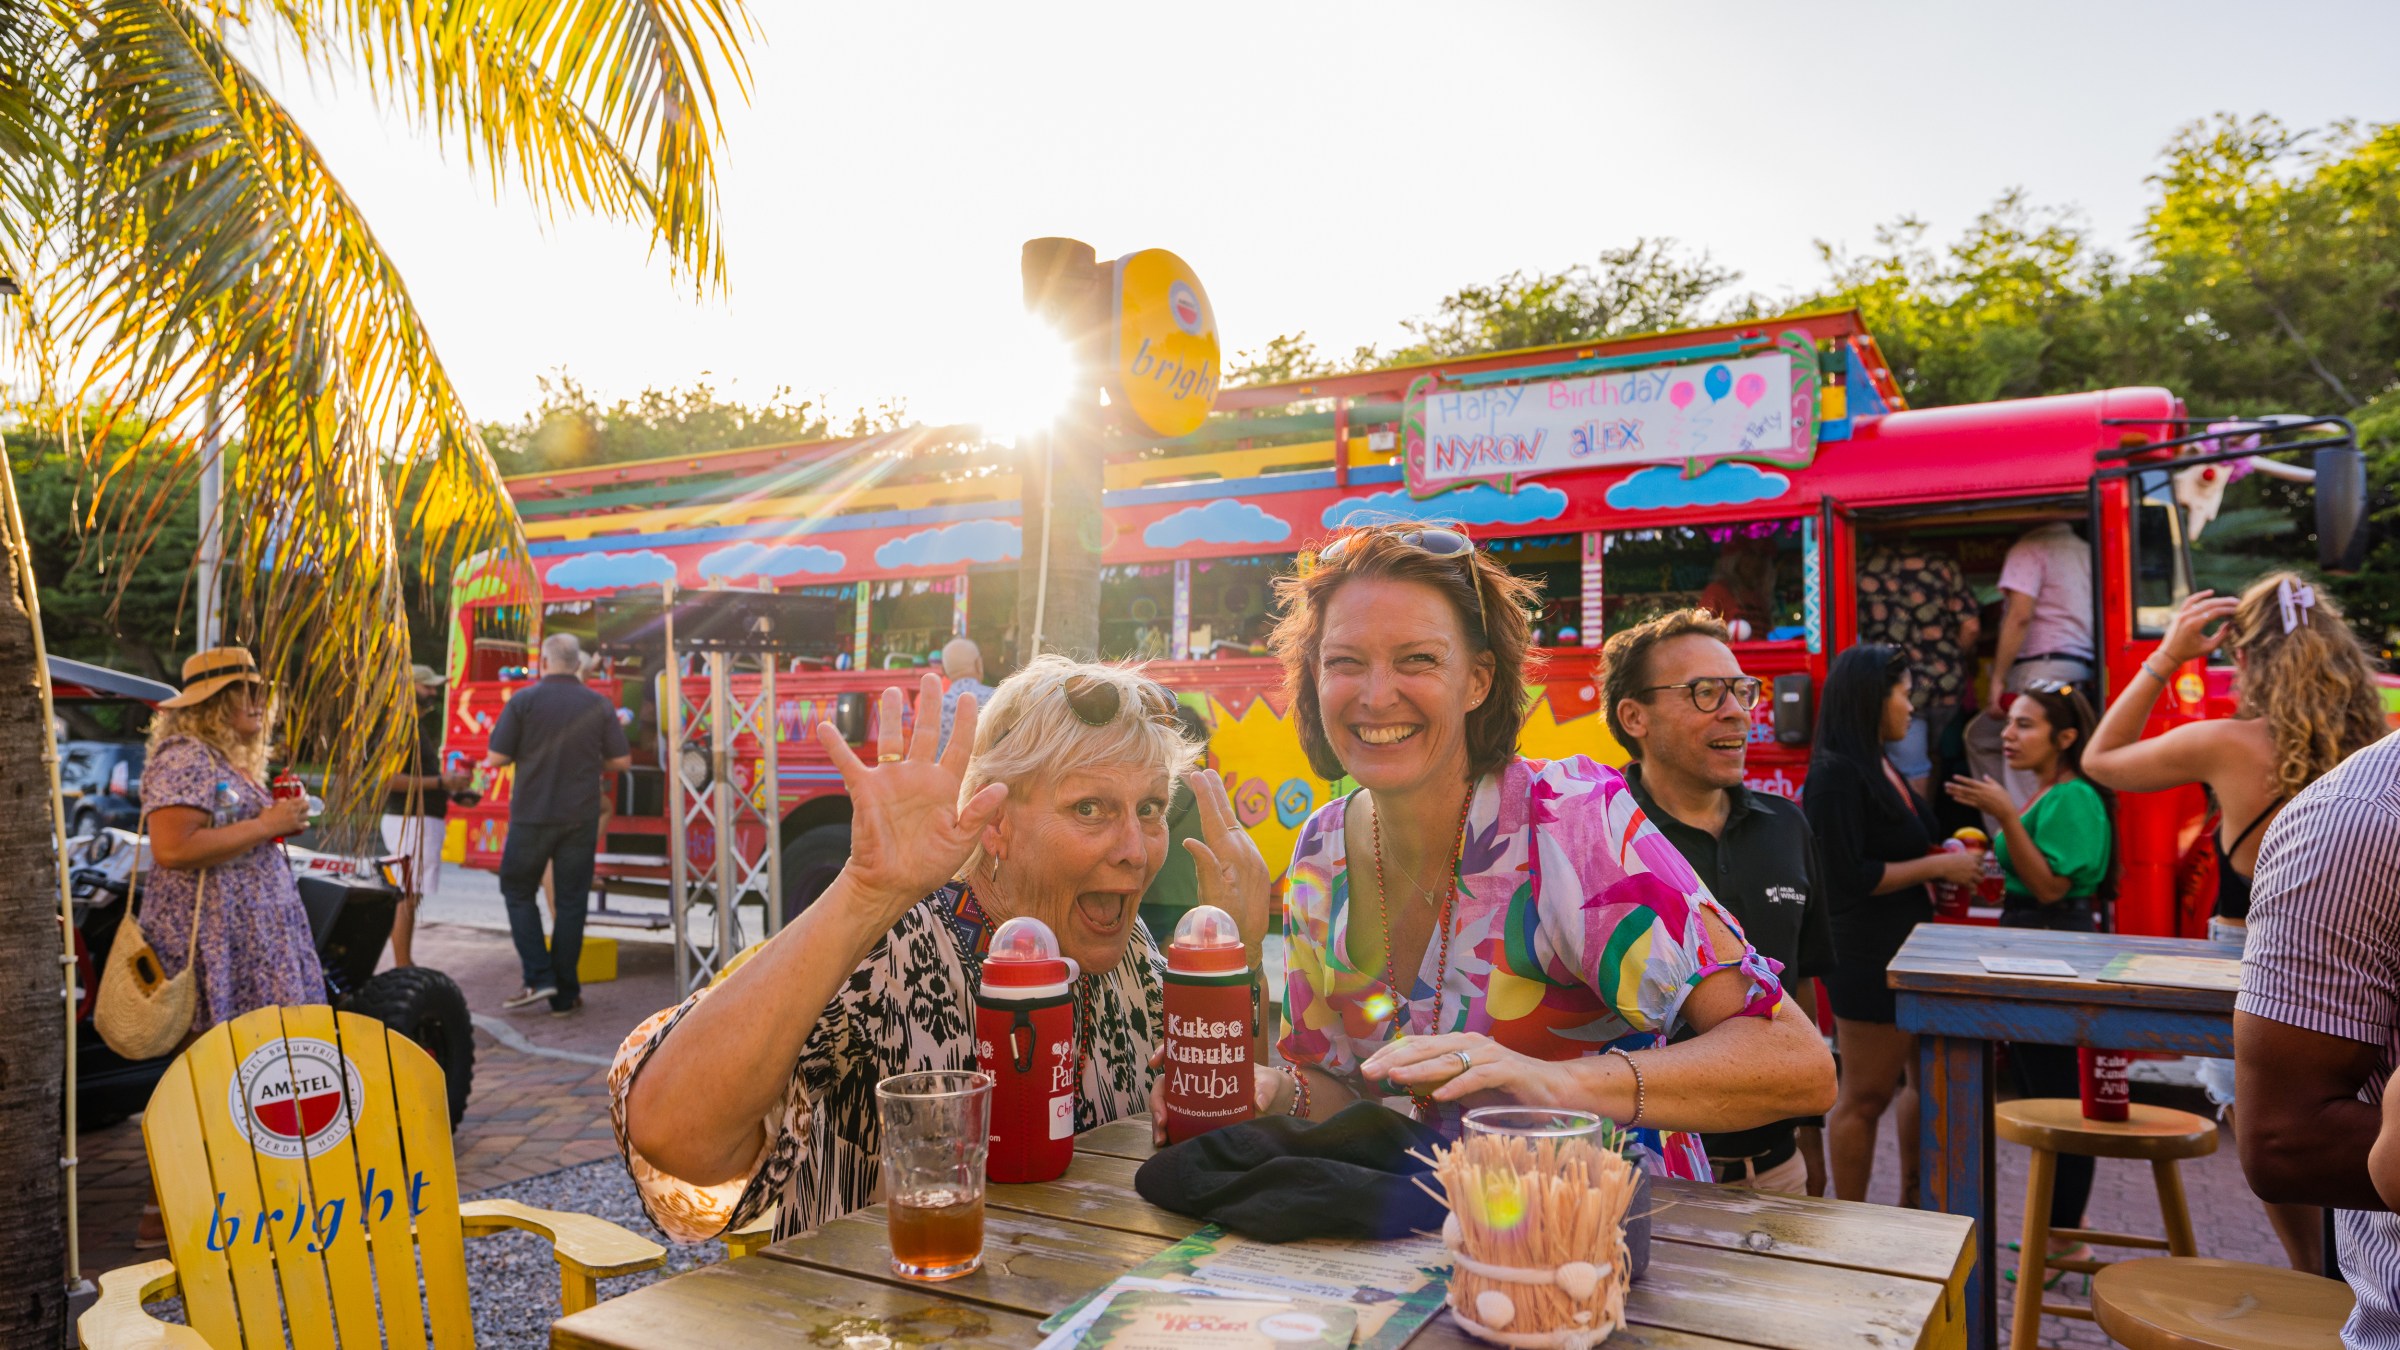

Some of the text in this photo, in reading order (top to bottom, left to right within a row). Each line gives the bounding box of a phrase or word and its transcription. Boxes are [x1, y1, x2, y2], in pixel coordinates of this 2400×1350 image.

[1131, 337, 1218, 402] bright
[1548, 370, 1672, 410] Birthday
[1433, 428, 1548, 475] NYRON
[1168, 1013, 1243, 1038] Kukoo
[1166, 1037, 1245, 1064] Kunuku
[261, 1075, 332, 1099] AMSTEL
[1048, 1064, 1073, 1093] Par
[1170, 1066, 1239, 1099] Aruba
[206, 1168, 431, 1253] bright
